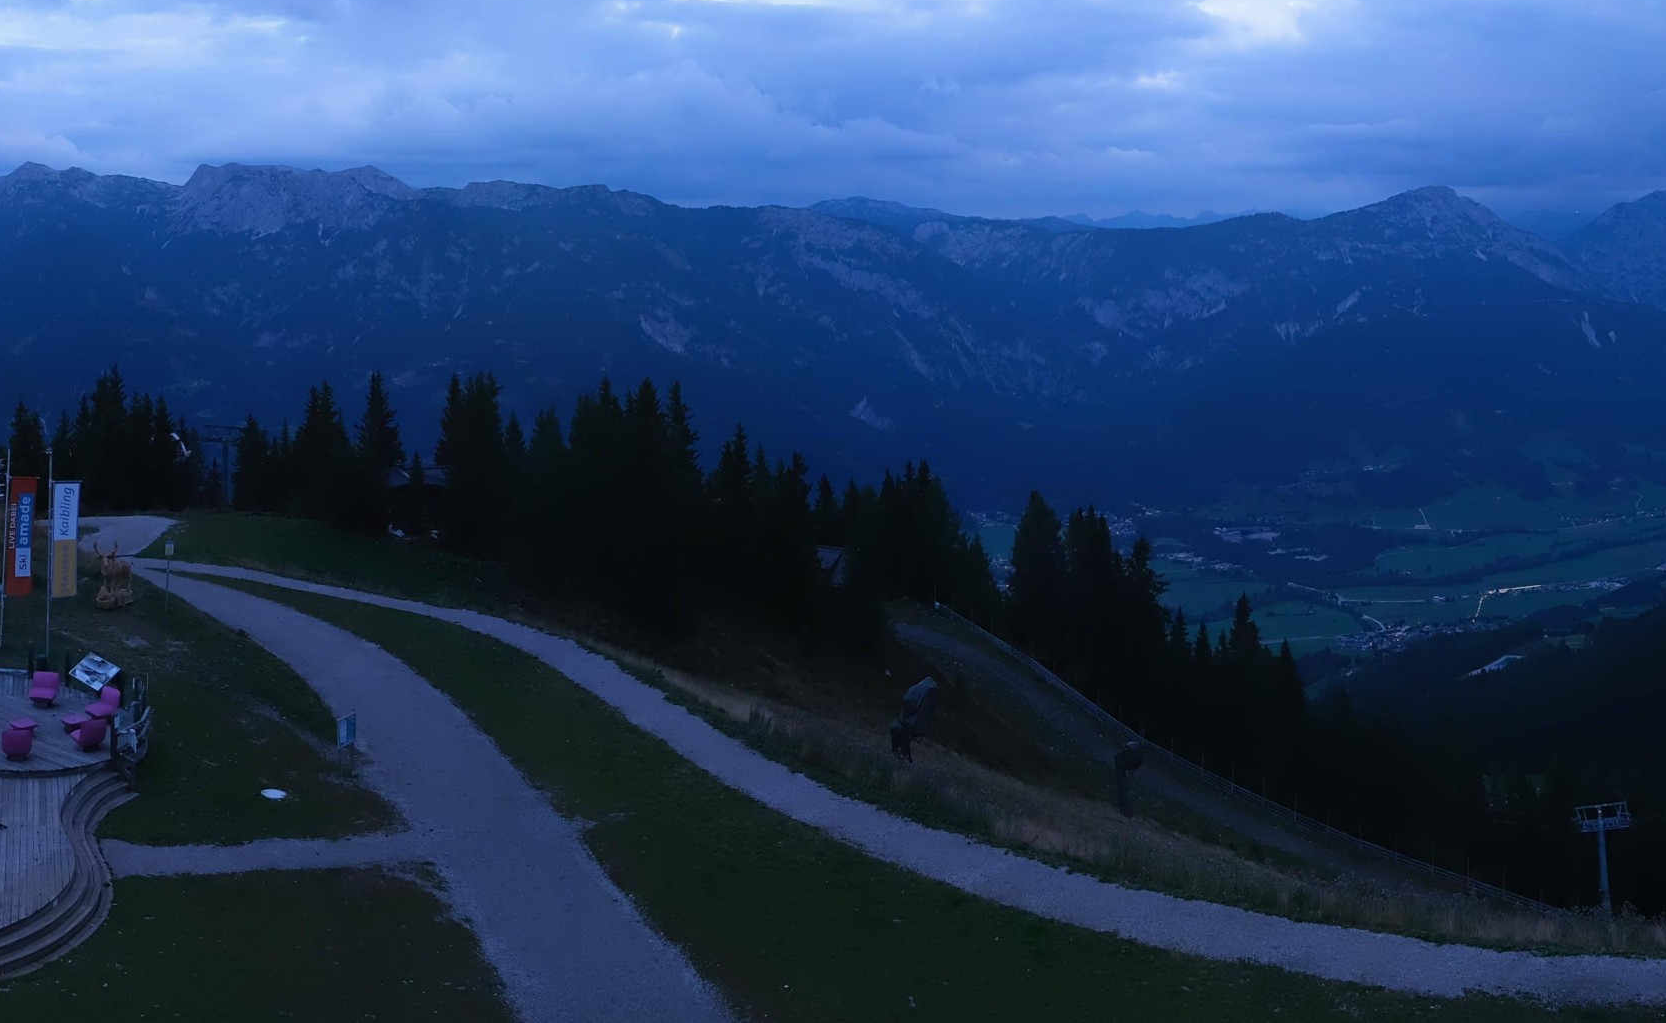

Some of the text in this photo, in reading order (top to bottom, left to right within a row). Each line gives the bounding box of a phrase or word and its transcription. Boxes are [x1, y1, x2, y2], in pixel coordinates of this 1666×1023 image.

[8, 503, 17, 550] LIVE DABEI
[59, 487, 75, 536] Kaibling
[19, 554, 27, 570] Ski
